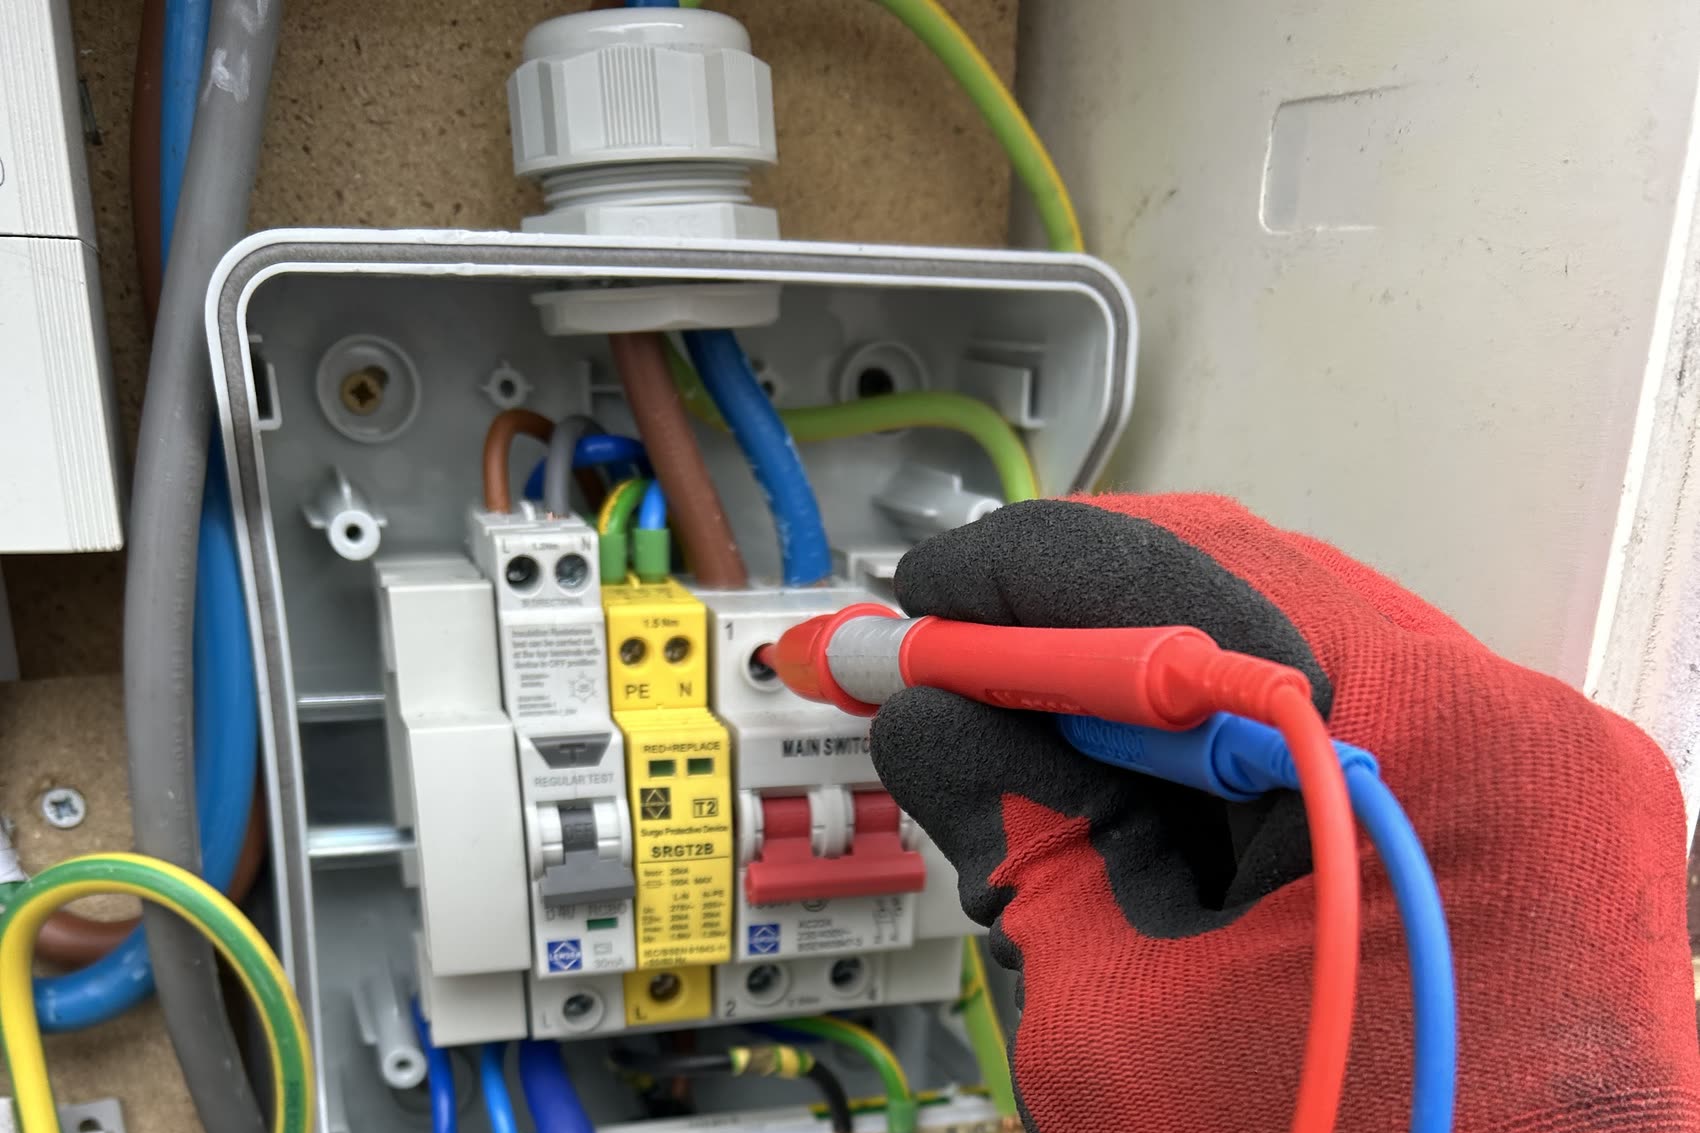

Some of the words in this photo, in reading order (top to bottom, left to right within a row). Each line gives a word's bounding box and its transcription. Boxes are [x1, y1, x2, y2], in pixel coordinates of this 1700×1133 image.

[503, 539, 510, 553] L
[581, 536, 591, 551] N
[725, 621, 734, 640] 1
[625, 684, 650, 700] PE
[679, 682, 692, 697] N
[782, 738, 821, 757] MAIN
[535, 775, 586, 788] REGULAR
[588, 773, 614, 785] TEST
[695, 801, 717, 816] T2
[651, 842, 714, 859] SRGT2B
[636, 1007, 646, 1020] L
[725, 1001, 737, 1017] 2
[542, 1012, 552, 1028] L
